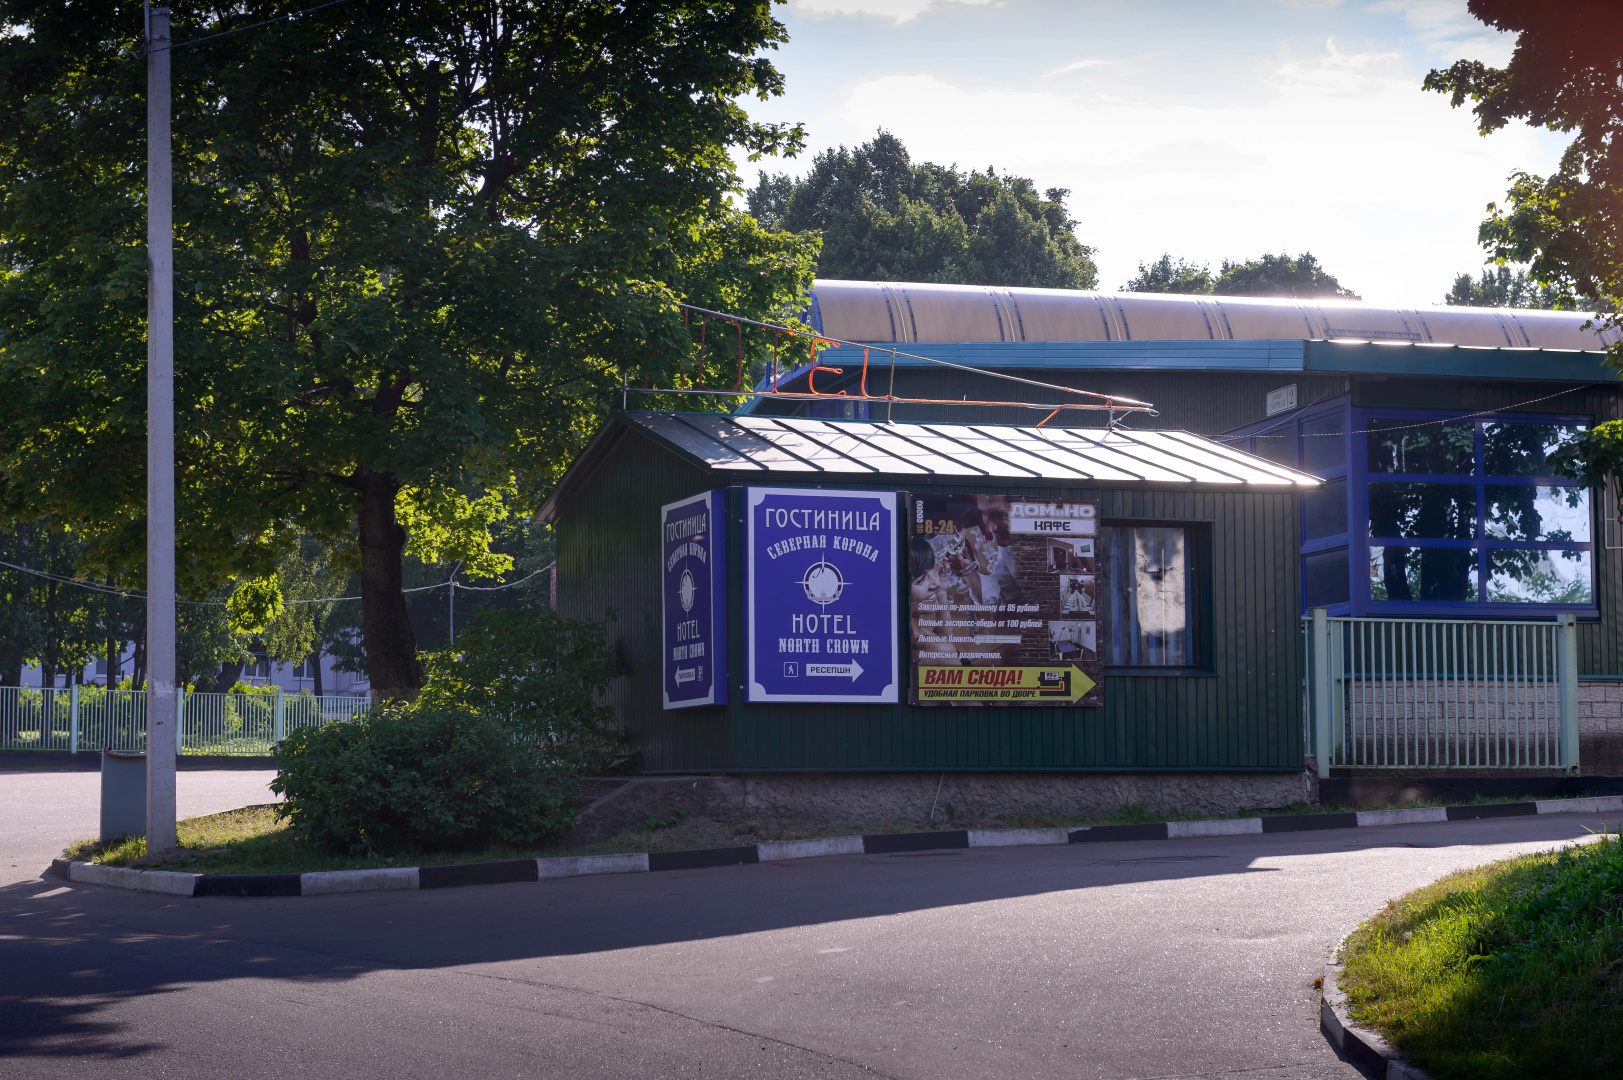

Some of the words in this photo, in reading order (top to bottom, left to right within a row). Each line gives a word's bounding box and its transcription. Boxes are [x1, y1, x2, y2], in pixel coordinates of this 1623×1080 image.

[666, 512, 707, 543] ГОСТИНИЦА
[765, 508, 880, 532] ГОСТИНИЦА
[924, 519, 954, 535] 8-24
[1034, 521, 1071, 531] КАФЕ
[766, 535, 827, 560] СЕВЕРНАЯ
[833, 535, 880, 563] КОРОНА
[918, 603, 948, 613] Завтраки
[949, 603, 997, 613] по-домашнему
[999, 604, 1006, 612] от
[1007, 603, 1016, 612] 85
[1016, 603, 1040, 613] рублей
[677, 619, 701, 642] HOTEL
[792, 613, 857, 635] HOTEL
[918, 618, 944, 628] Полные
[944, 619, 997, 629] экспресс-обеды
[998, 620, 1005, 628] от
[1007, 619, 1019, 628] 100
[1019, 620, 1043, 629] рублей
[778, 638, 820, 653] NORTH
[826, 639, 869, 654] CROWN
[918, 635, 947, 644] Пышные
[948, 635, 976, 644] банкеты
[918, 650, 958, 660] Интересные
[959, 652, 1002, 661] развлечения.
[810, 666, 851, 674] РЕСЕПШН
[924, 669, 963, 685] ВАМ
[967, 669, 1023, 687] СЮДА!
[924, 690, 959, 698] УДОБНАЯ
[959, 690, 999, 698] ПАРКОВКА
[1000, 690, 1010, 698] ВО
[1012, 690, 1037, 698] ДВОРЕ
